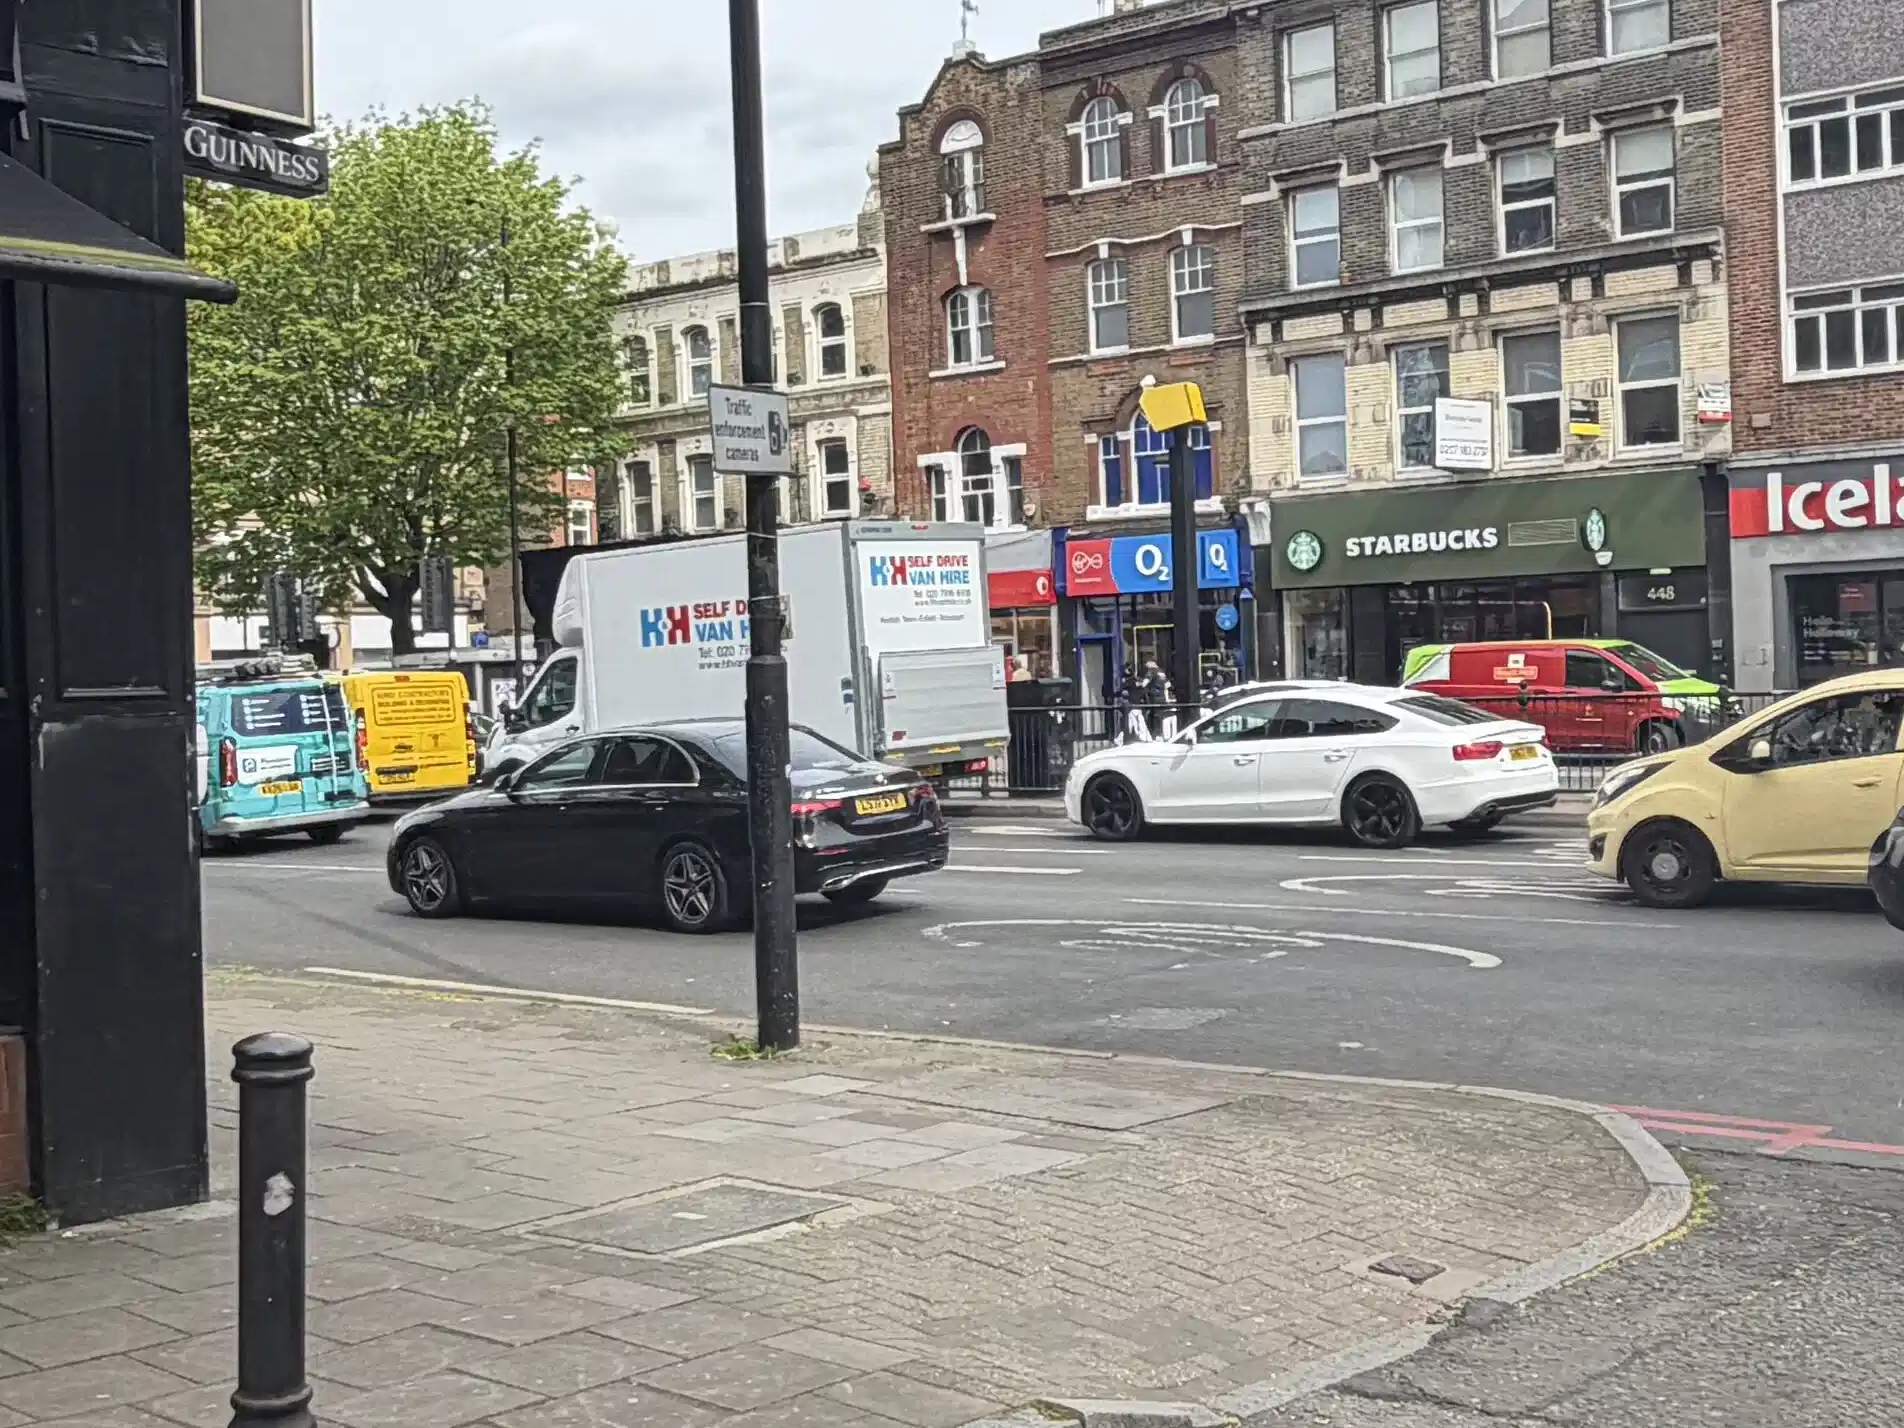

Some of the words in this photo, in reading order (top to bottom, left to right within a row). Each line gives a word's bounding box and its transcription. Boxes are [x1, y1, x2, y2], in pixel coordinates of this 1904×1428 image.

[183, 125, 320, 181] GUINNESS
[724, 396, 753, 417] Traffic
[714, 419, 766, 440] enforcement
[725, 447, 760, 462] cameras
[1345, 527, 1498, 558] STARBUCKS
[907, 555, 934, 569] SELF
[936, 554, 969, 568] DRIVE
[908, 570, 937, 586] VAN
[940, 569, 970, 585] HIRE
[1647, 585, 1676, 601] 448
[693, 600, 731, 619] SELF
[695, 620, 734, 642] VAN
